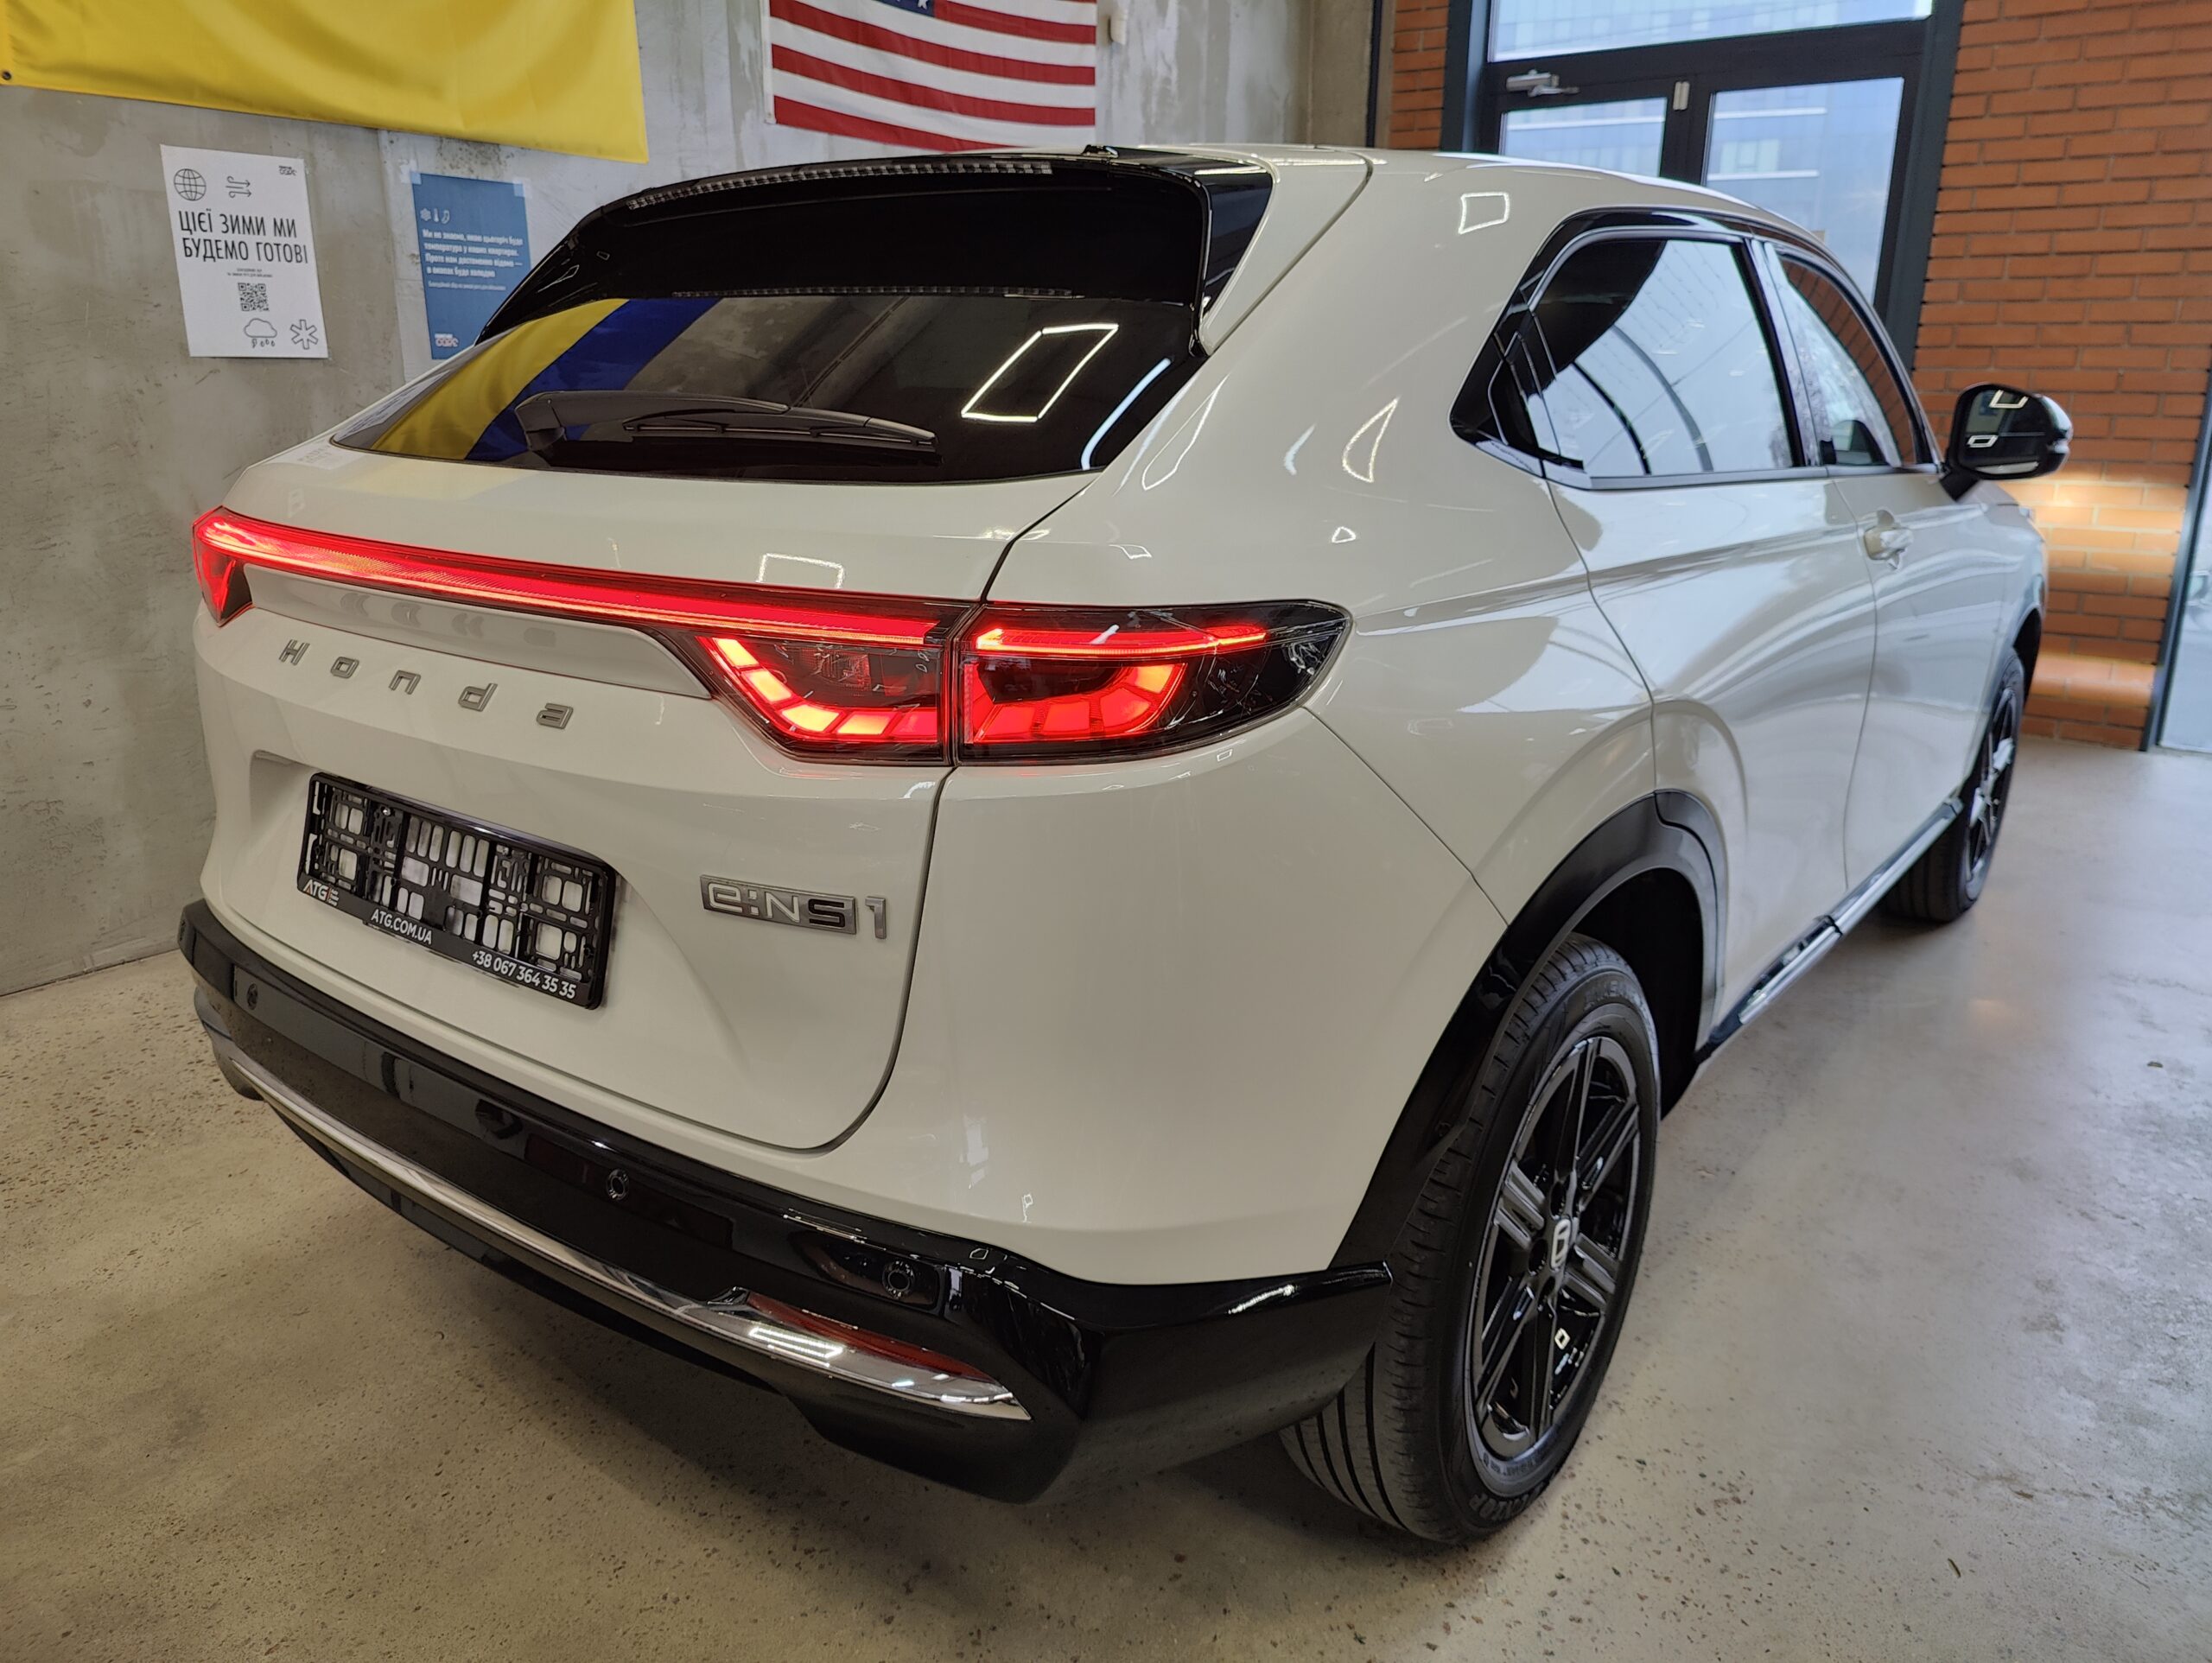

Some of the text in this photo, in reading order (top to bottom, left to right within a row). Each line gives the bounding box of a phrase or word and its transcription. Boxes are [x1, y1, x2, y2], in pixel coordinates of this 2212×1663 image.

[179, 208, 297, 238] ЦІЄЇ ЗИМИ МИ
[182, 238, 308, 263] БУДЕМО ГОТОВІ
[371, 909, 432, 944] ATG.COM.UA
[472, 950, 576, 999] +38 067 364 35 35
